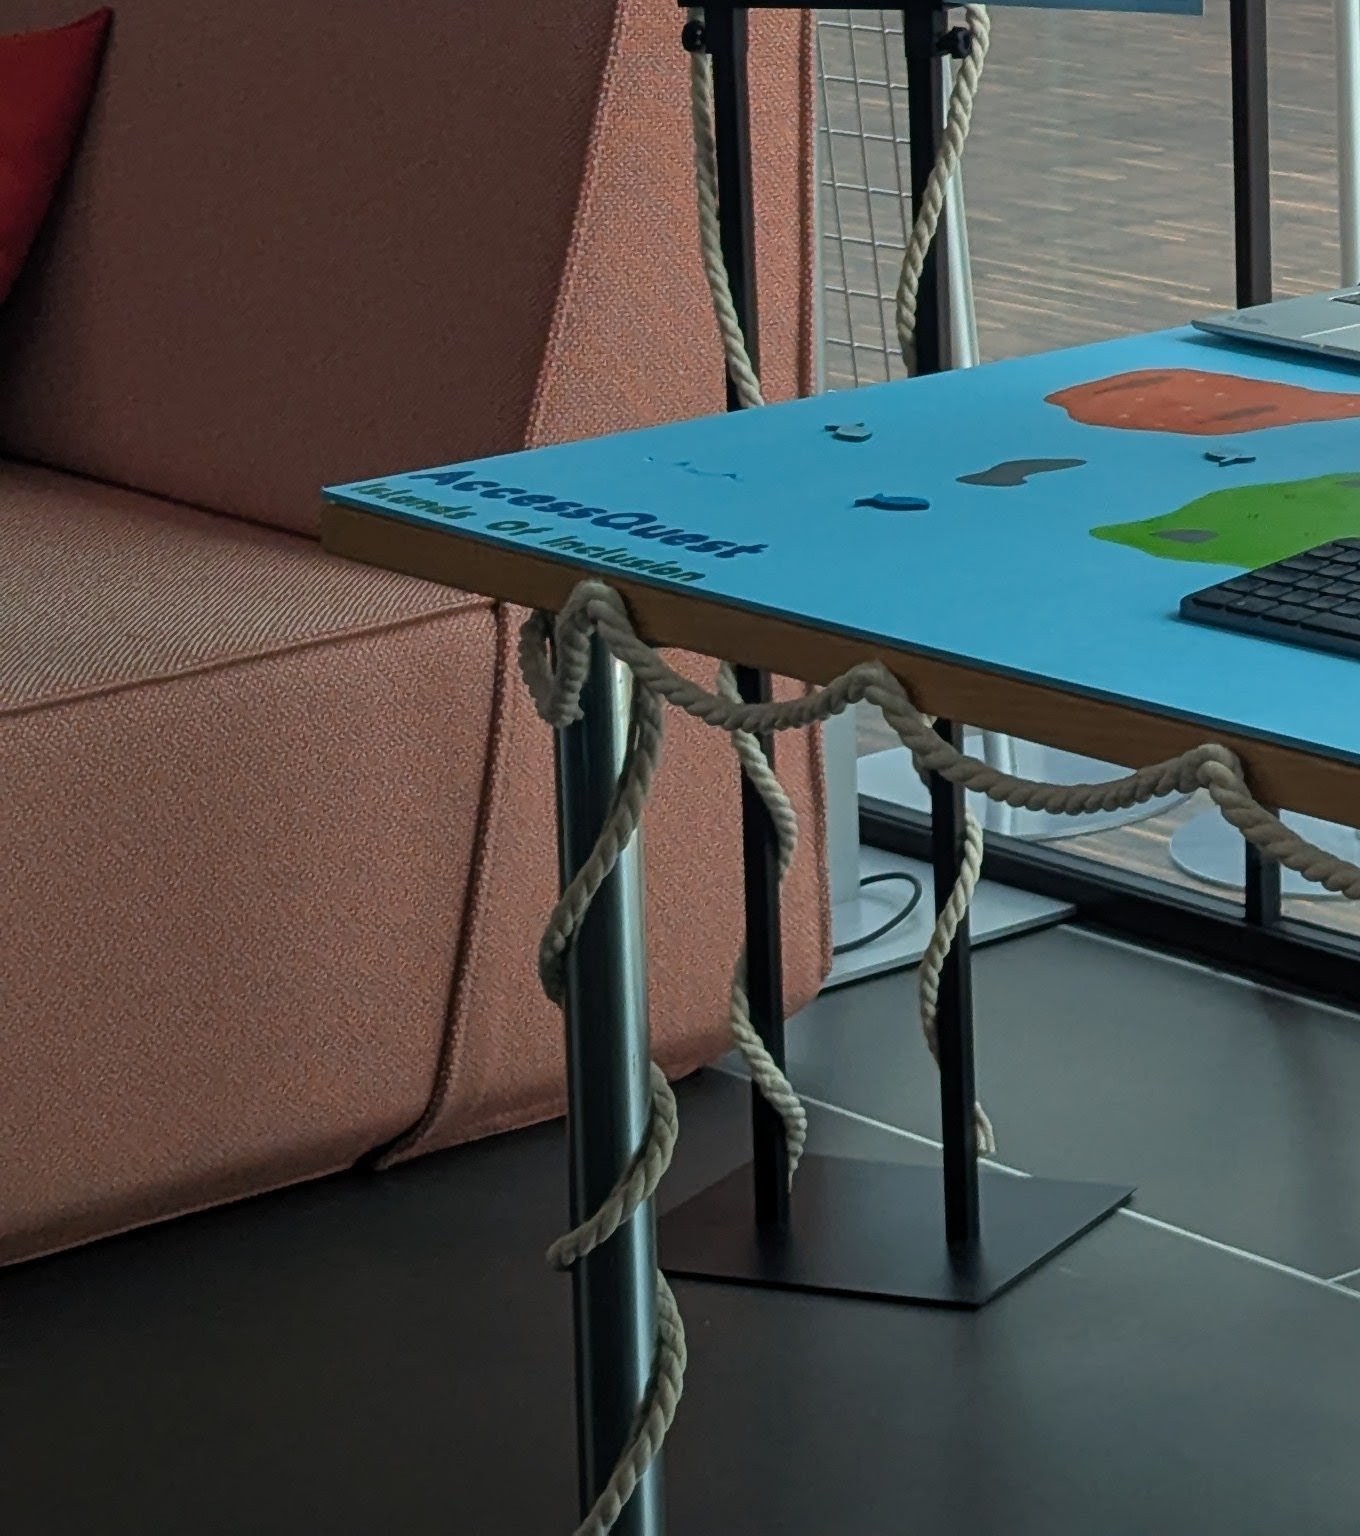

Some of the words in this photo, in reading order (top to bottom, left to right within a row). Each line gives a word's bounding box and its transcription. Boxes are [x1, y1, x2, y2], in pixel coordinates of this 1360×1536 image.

[350, 482, 477, 520] Islands
[485, 520, 554, 536] Of
[539, 535, 707, 583] Inclusion
[409, 470, 769, 559] AccessQuest
